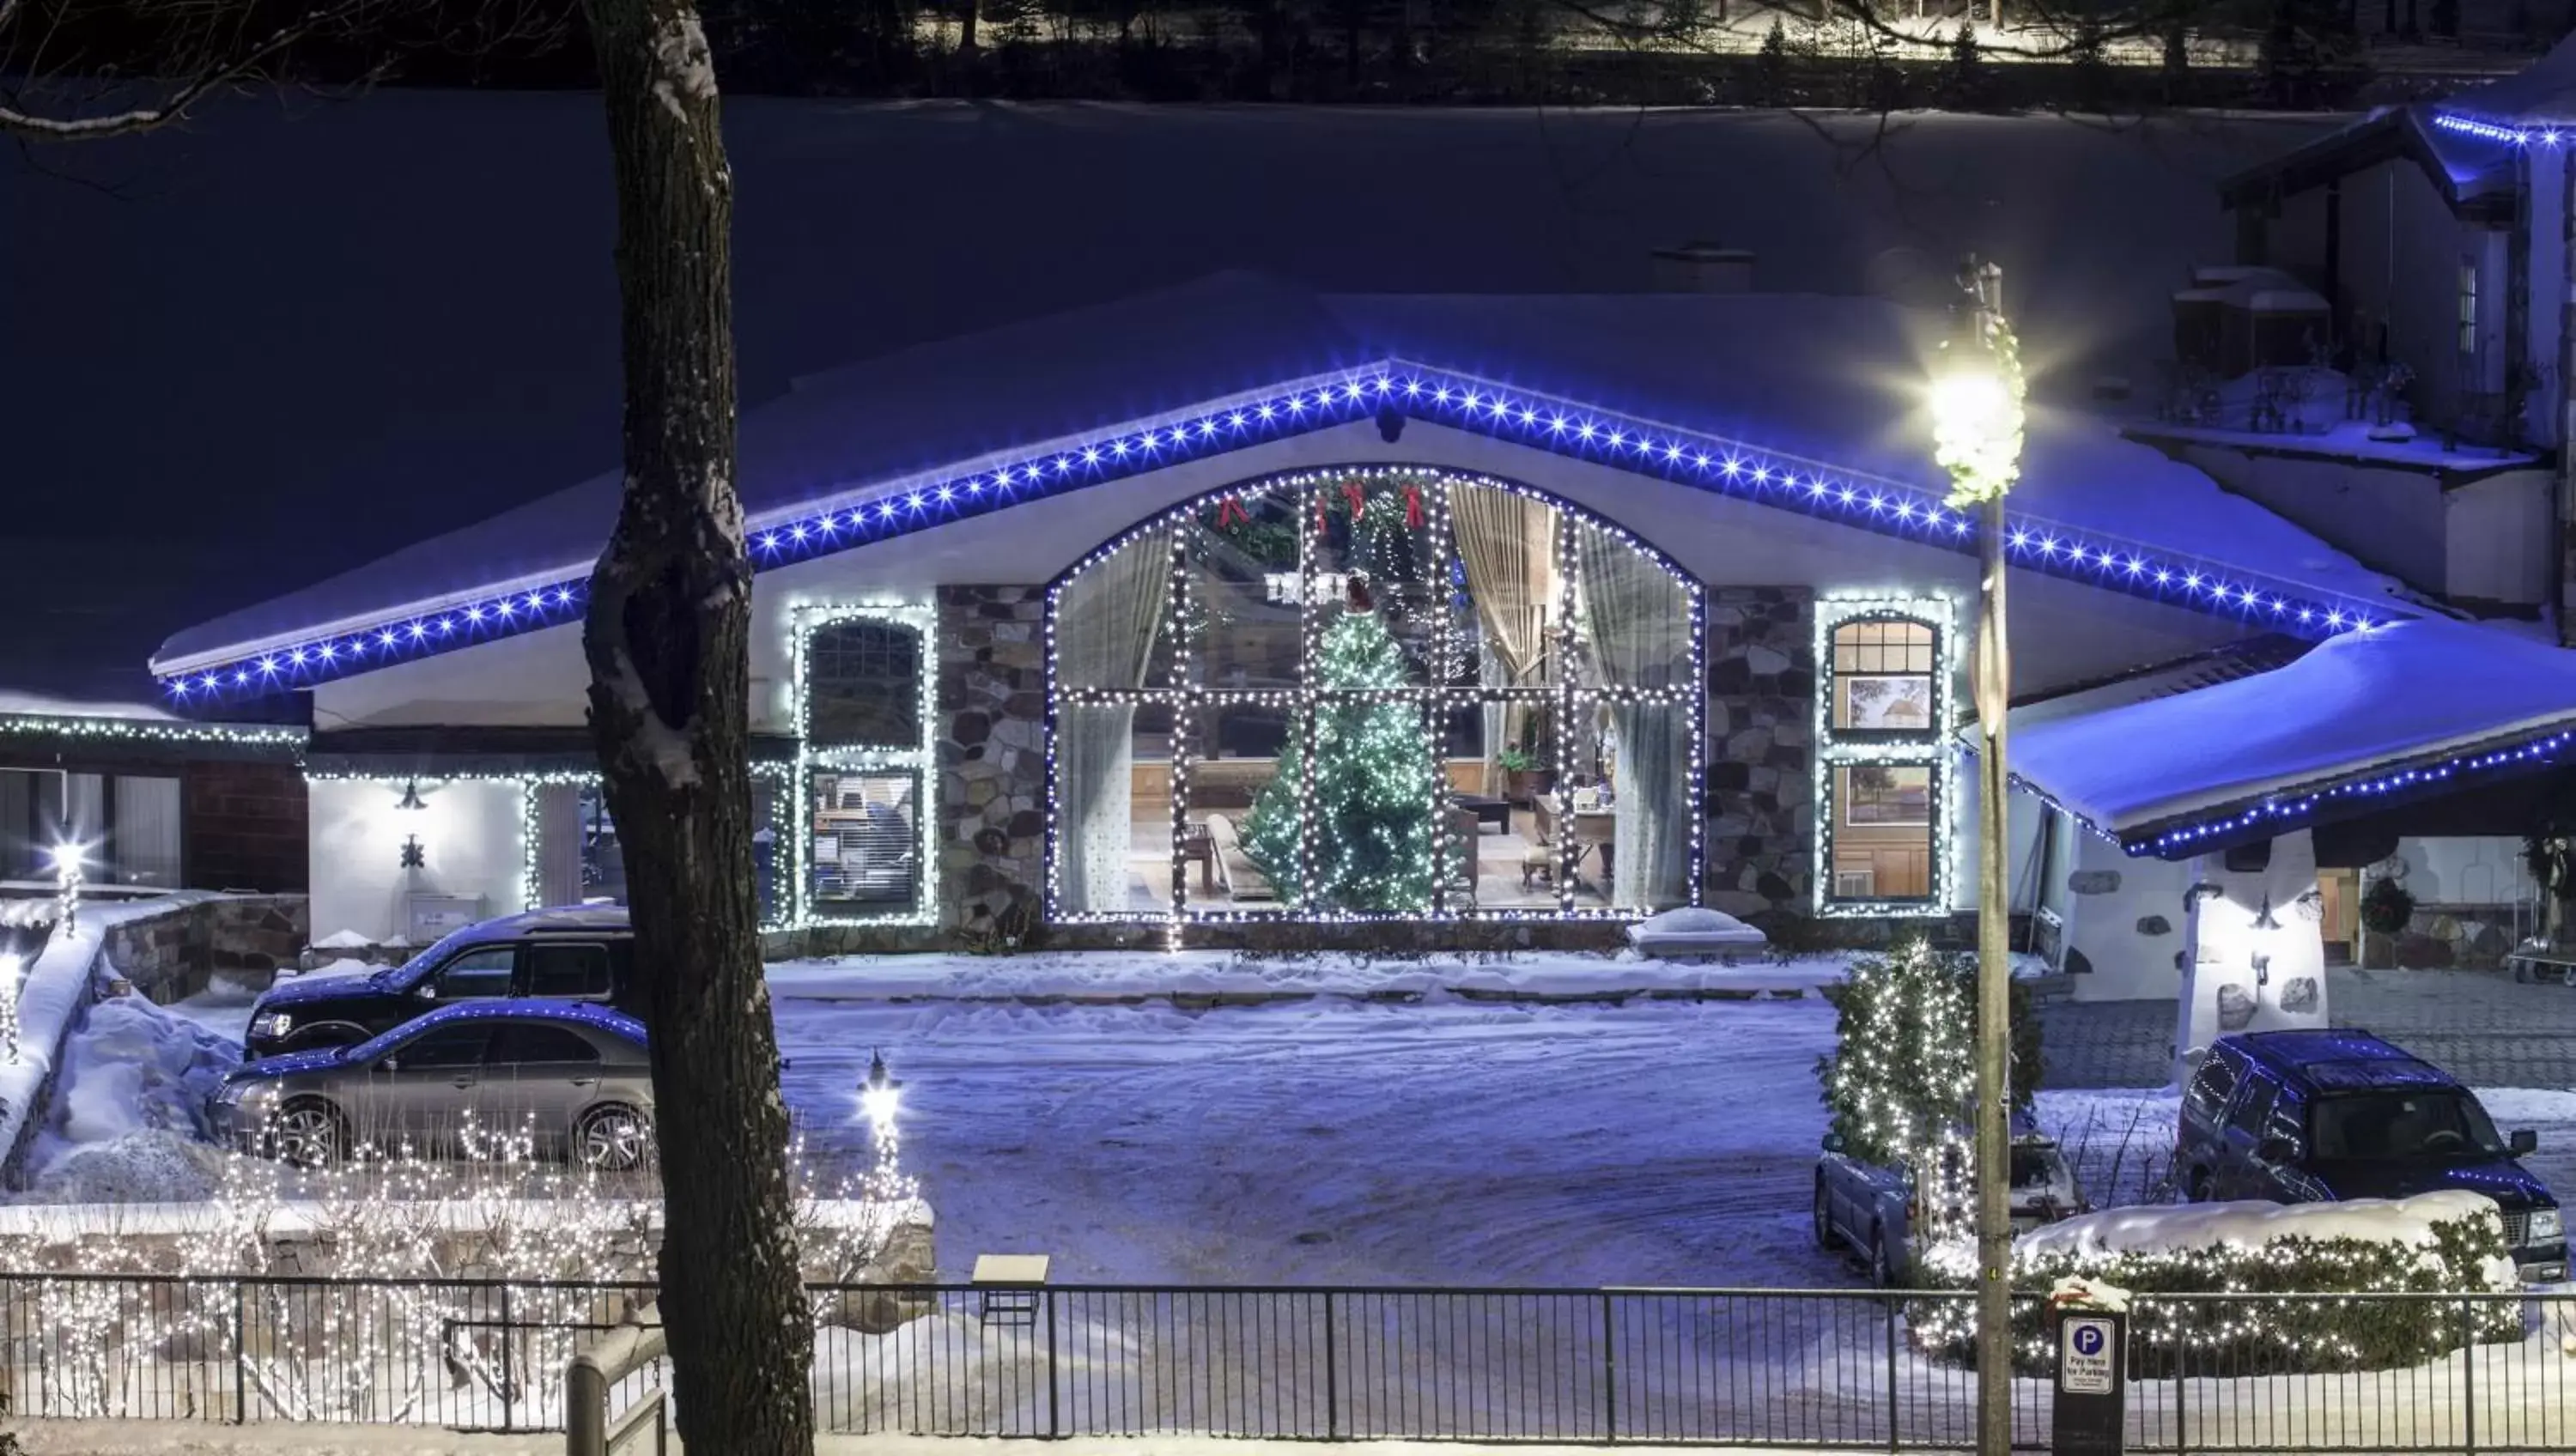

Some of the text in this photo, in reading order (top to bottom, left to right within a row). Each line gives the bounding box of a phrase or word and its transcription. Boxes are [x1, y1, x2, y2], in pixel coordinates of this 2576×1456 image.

[2082, 1330, 2097, 1351] P
[2070, 1356, 2085, 1367] Pay
[2079, 1367, 2109, 1379] Parking
